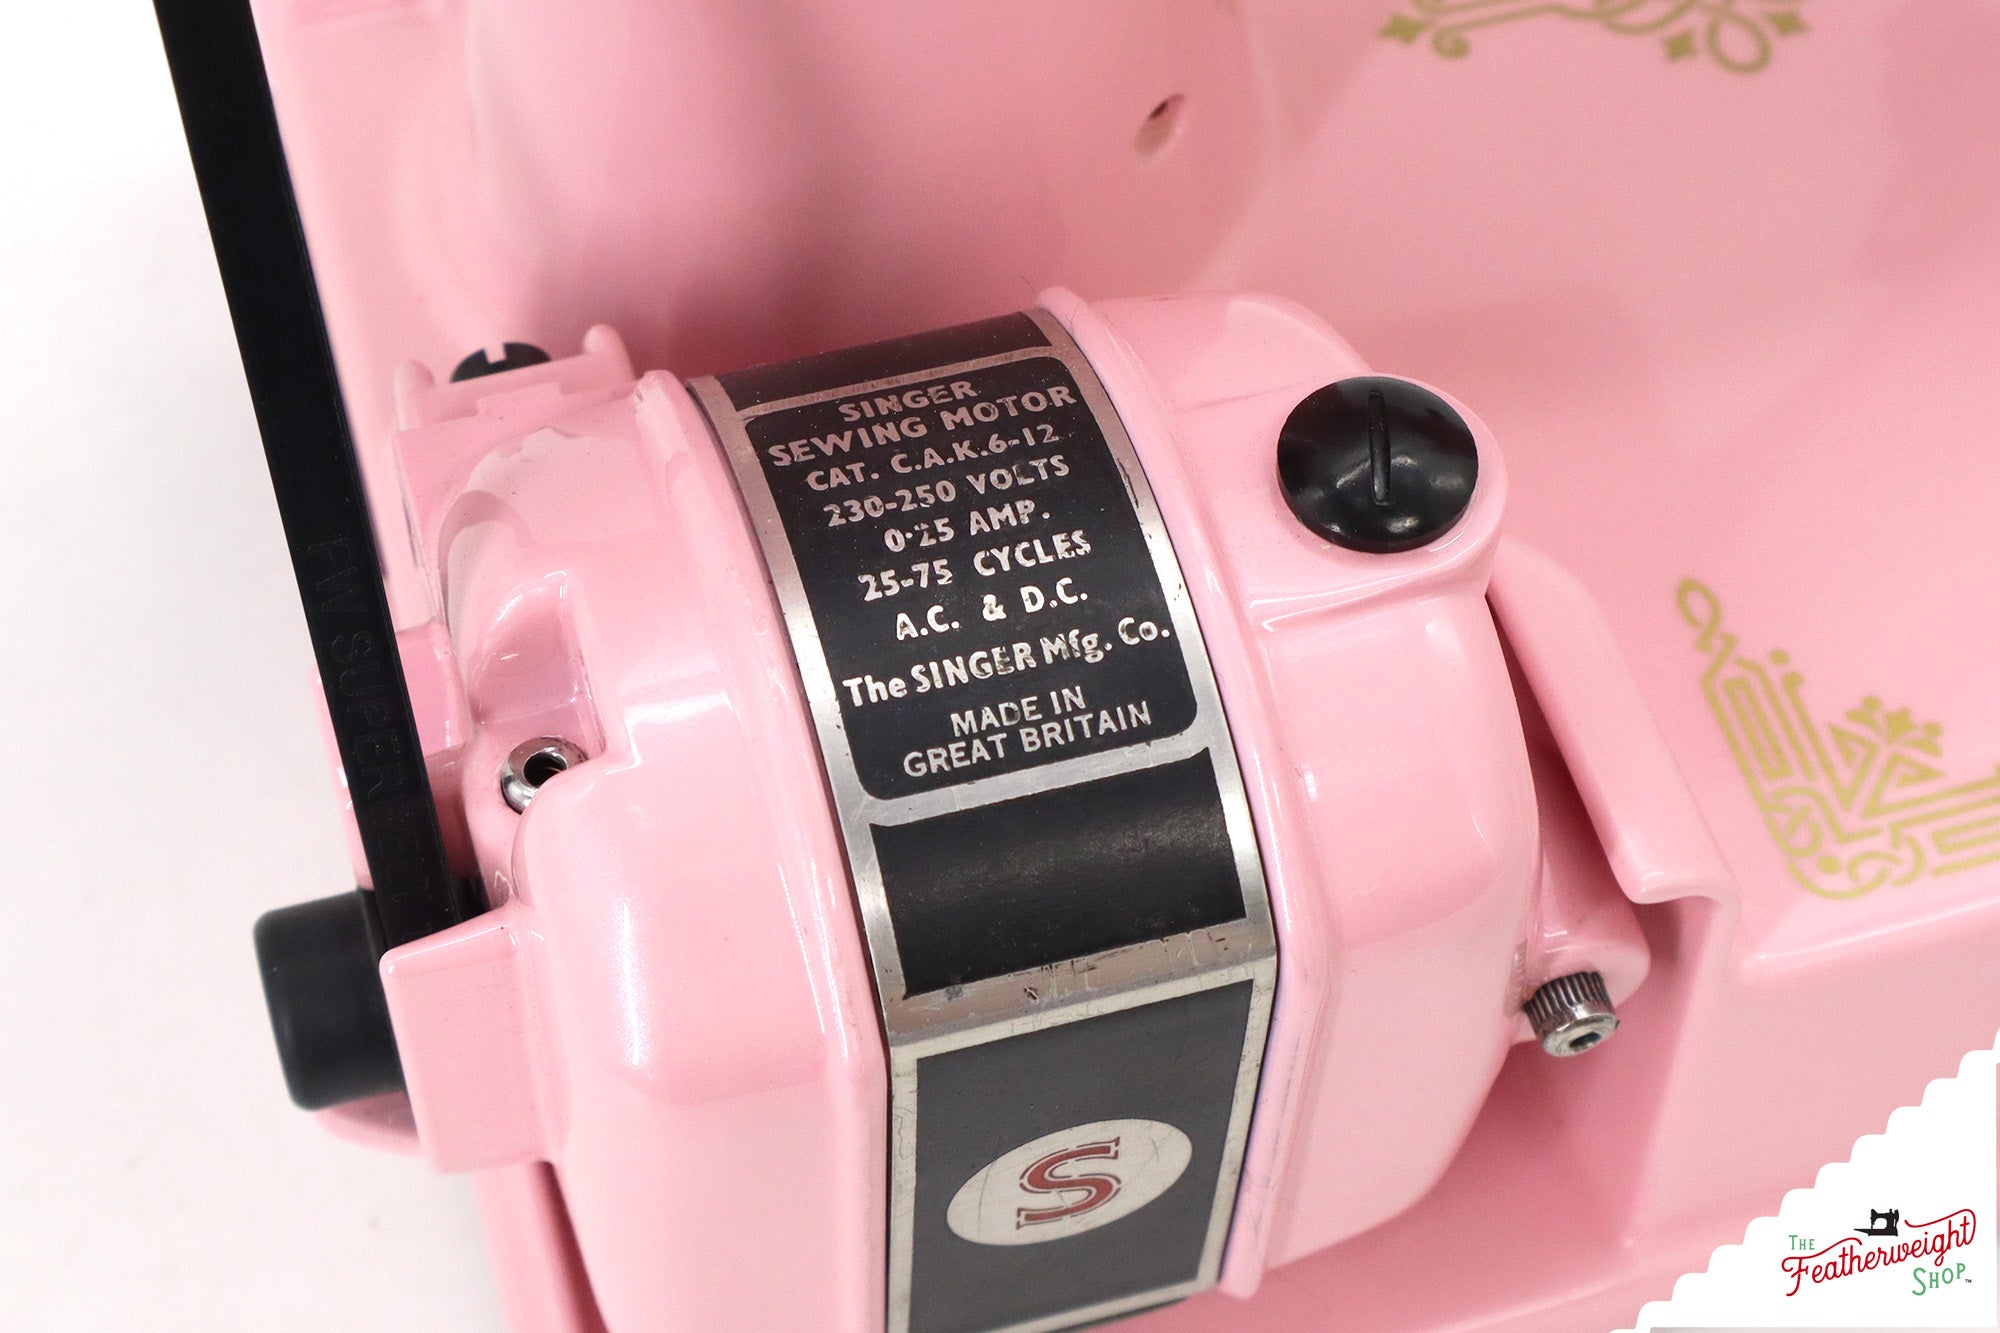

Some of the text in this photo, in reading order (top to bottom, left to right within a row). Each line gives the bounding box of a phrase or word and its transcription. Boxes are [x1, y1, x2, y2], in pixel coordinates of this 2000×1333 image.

[768, 386, 1077, 467] SEWING MOTOR
[839, 381, 978, 423] SINGER
[807, 462, 880, 492] CAT.
[823, 455, 1070, 527] 230-250 VOLTS
[969, 499, 1050, 535] AMP.
[858, 530, 1092, 602] 25-75 CYCLES
[895, 578, 1088, 641] A.C. & D.C.
[842, 617, 1170, 707] The SINGER Mfg. Co.
[903, 700, 1153, 778] GREAT BRITAIN
[950, 686, 1087, 738] MADE IN
[1016, 1136, 1122, 1230] S
